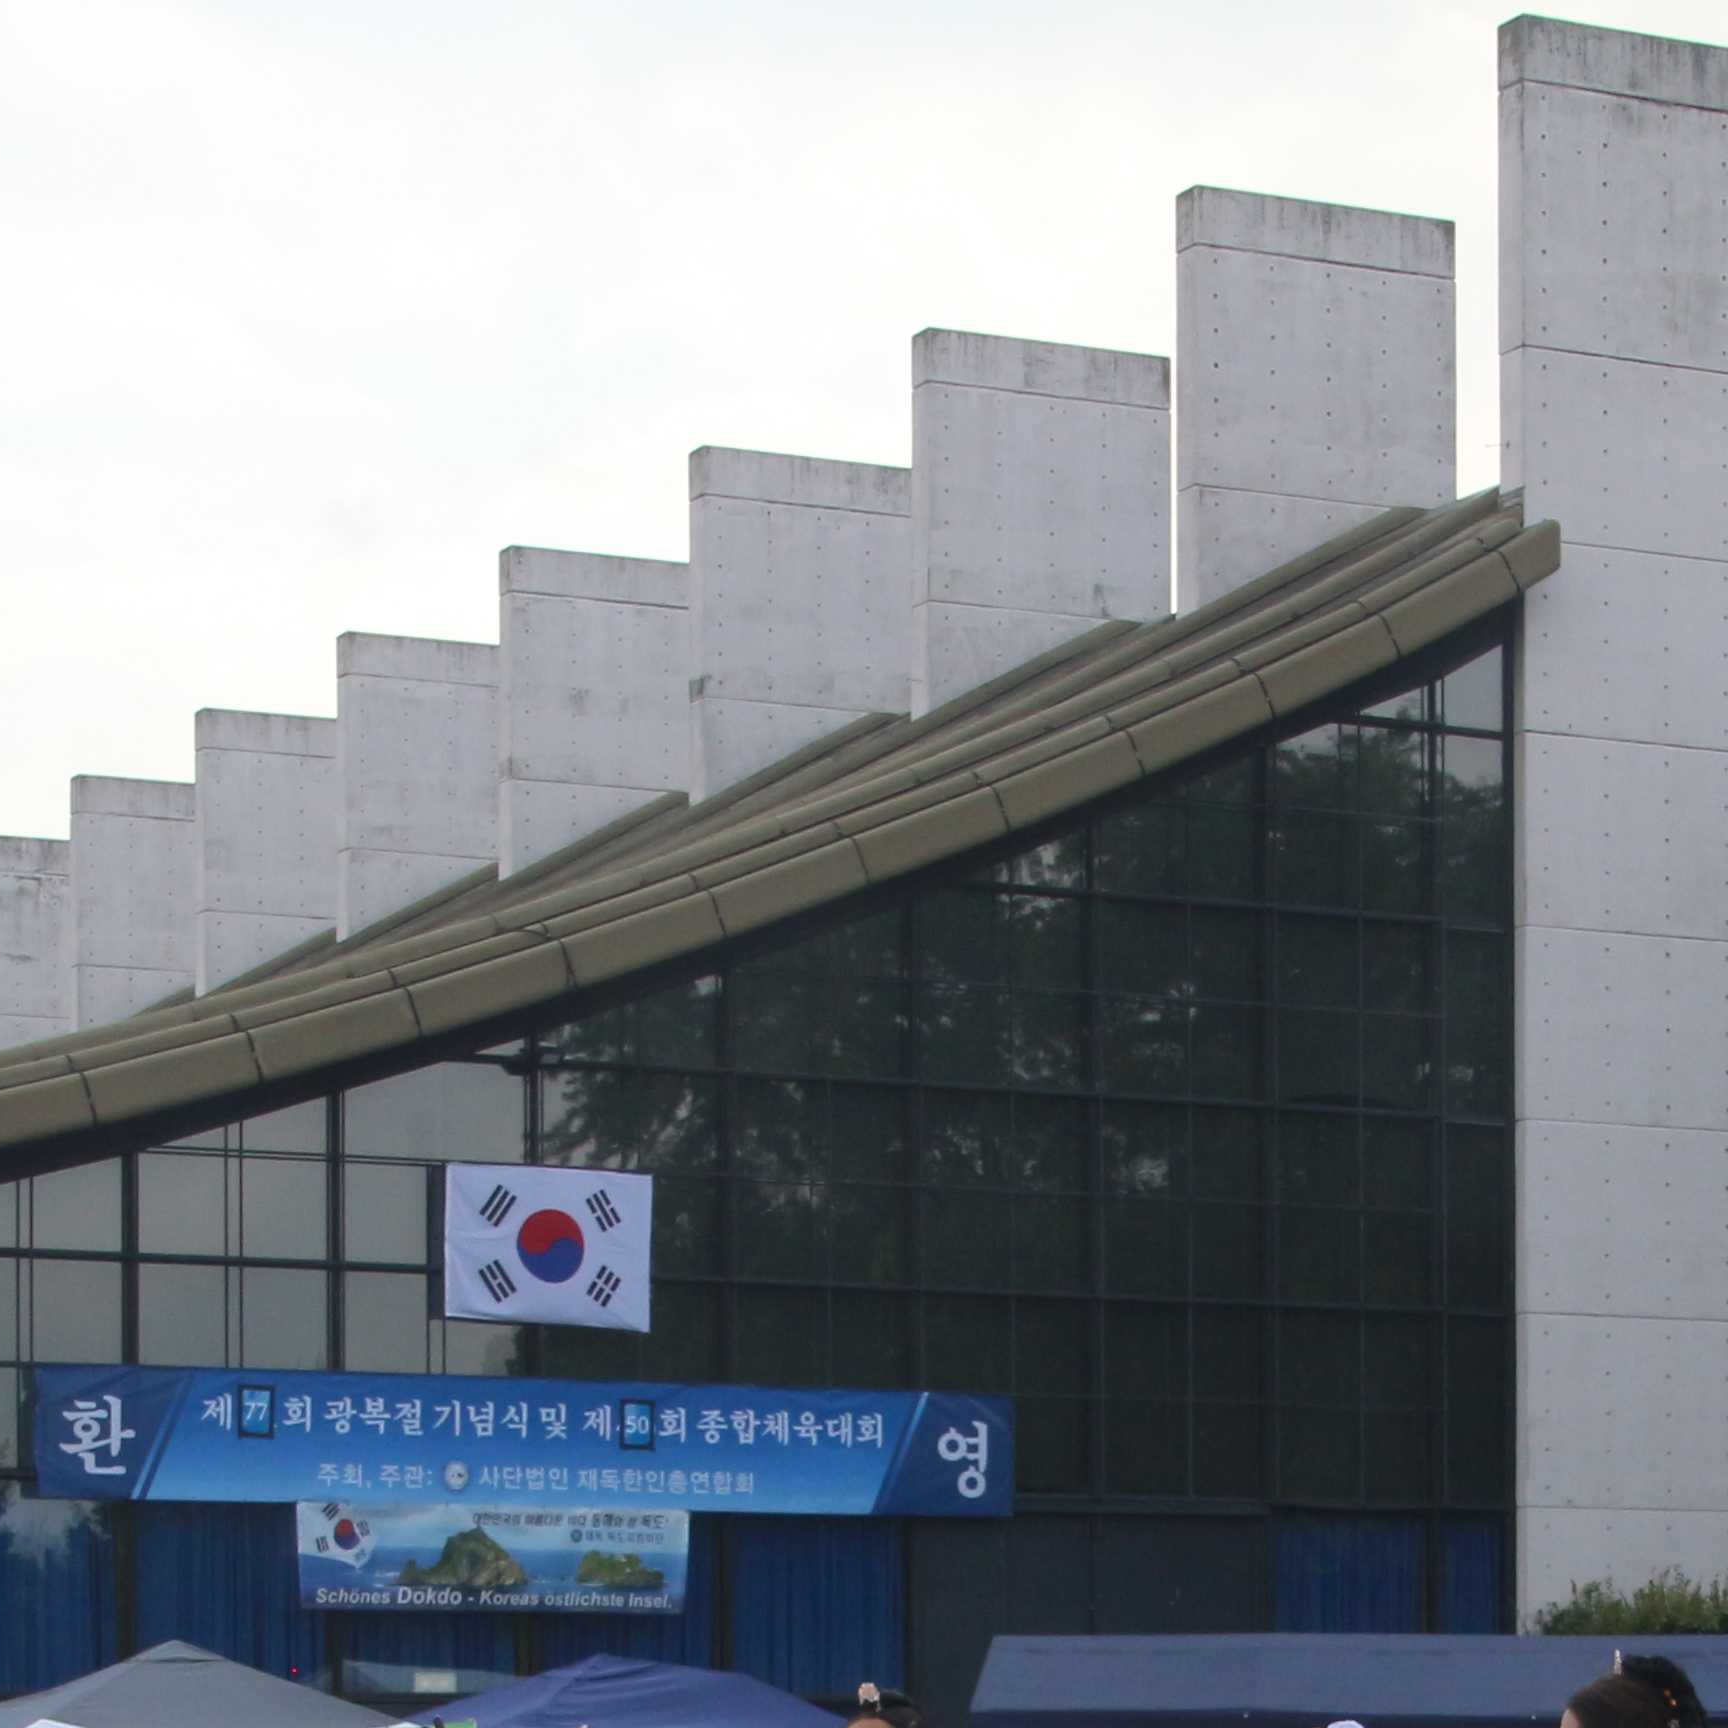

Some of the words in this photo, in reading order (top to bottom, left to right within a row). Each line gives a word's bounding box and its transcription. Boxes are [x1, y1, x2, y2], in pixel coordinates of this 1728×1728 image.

[58, 1393, 137, 1476] 환
[323, 1396, 423, 1436] 광복절
[432, 1398, 529, 1438] 기념식
[539, 1403, 568, 1438] 및
[696, 1409, 885, 1448] 종합체육대회
[478, 1465, 570, 1491] 사단법인
[577, 1467, 755, 1495] 재독한인총연합회
[936, 1420, 989, 1499] 영
[315, 1587, 391, 1604] Schönes
[396, 1586, 463, 1606] Dokdo
[479, 1589, 539, 1606] Koreas
[544, 1591, 624, 1608] östlichste
[628, 1593, 673, 1610] Insel.
